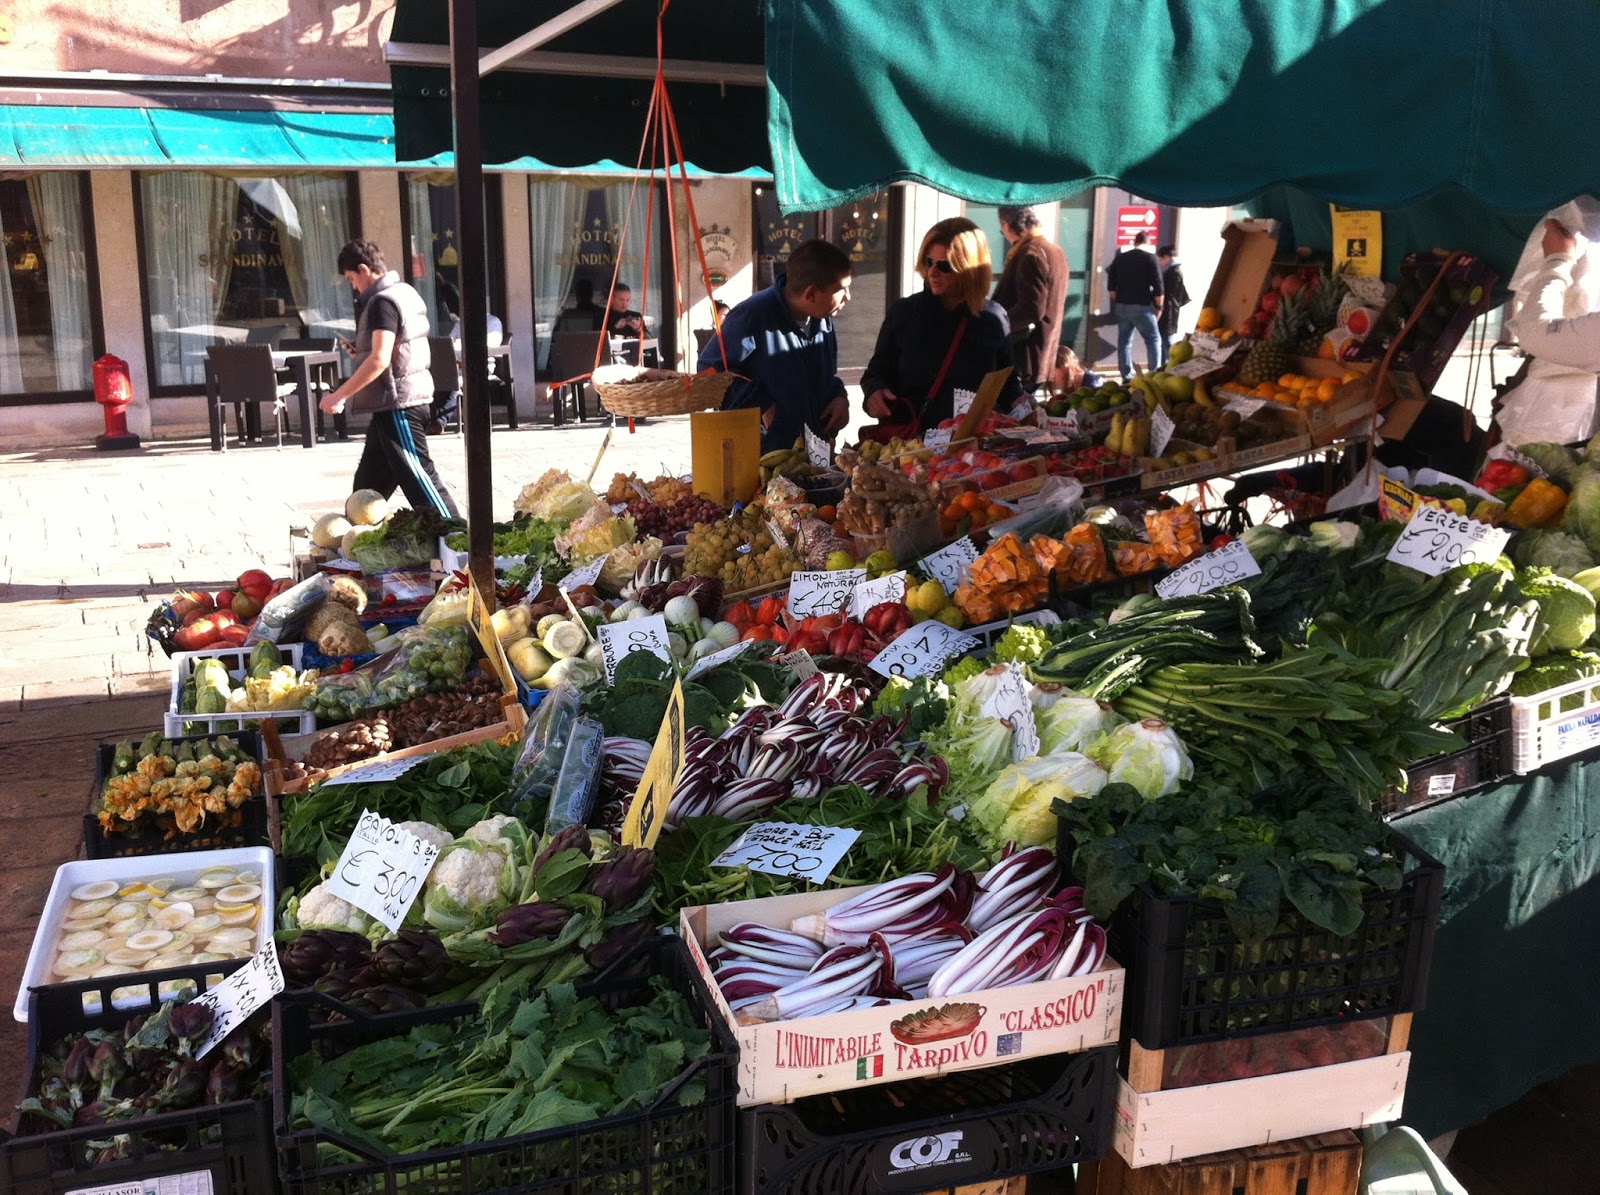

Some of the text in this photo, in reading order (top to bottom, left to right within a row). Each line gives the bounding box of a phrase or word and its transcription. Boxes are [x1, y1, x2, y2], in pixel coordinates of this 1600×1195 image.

[1417, 507, 1469, 533] VERZE
[1396, 528, 1476, 566] € 2,00
[793, 573, 832, 582] LIMONI
[1157, 559, 1201, 591] CICORIA
[1189, 560, 1238, 594] 2,00
[793, 590, 815, 618] €
[360, 815, 407, 845] CAVOLI
[744, 834, 793, 845] VERACE
[747, 824, 788, 836] CUORE
[805, 827, 835, 840] BUE
[718, 843, 823, 872] € 7,00
[341, 849, 417, 905] € 3,00
[1000, 979, 1105, 1032] "CLASSICO"
[775, 1029, 883, 1069] L'INIMITABILE
[894, 1029, 988, 1071] TARDIVO
[889, 1129, 963, 1169] COF
